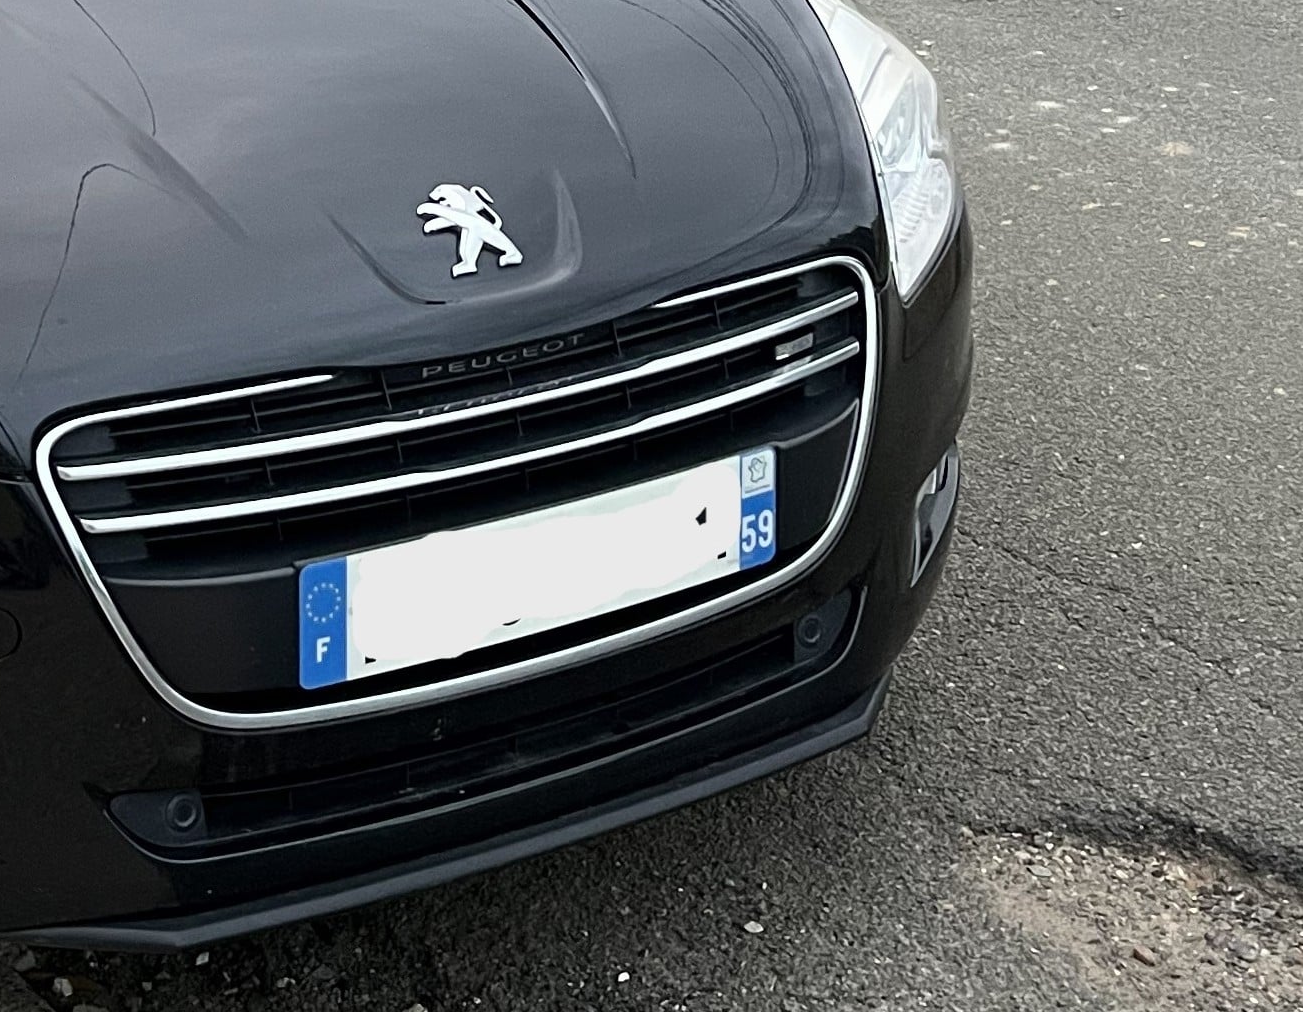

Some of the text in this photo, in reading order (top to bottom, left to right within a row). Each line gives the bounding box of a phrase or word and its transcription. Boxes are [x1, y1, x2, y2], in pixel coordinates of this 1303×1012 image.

[422, 333, 585, 378] PEUGEOT
[742, 509, 773, 553] 59
[316, 636, 331, 663] F
